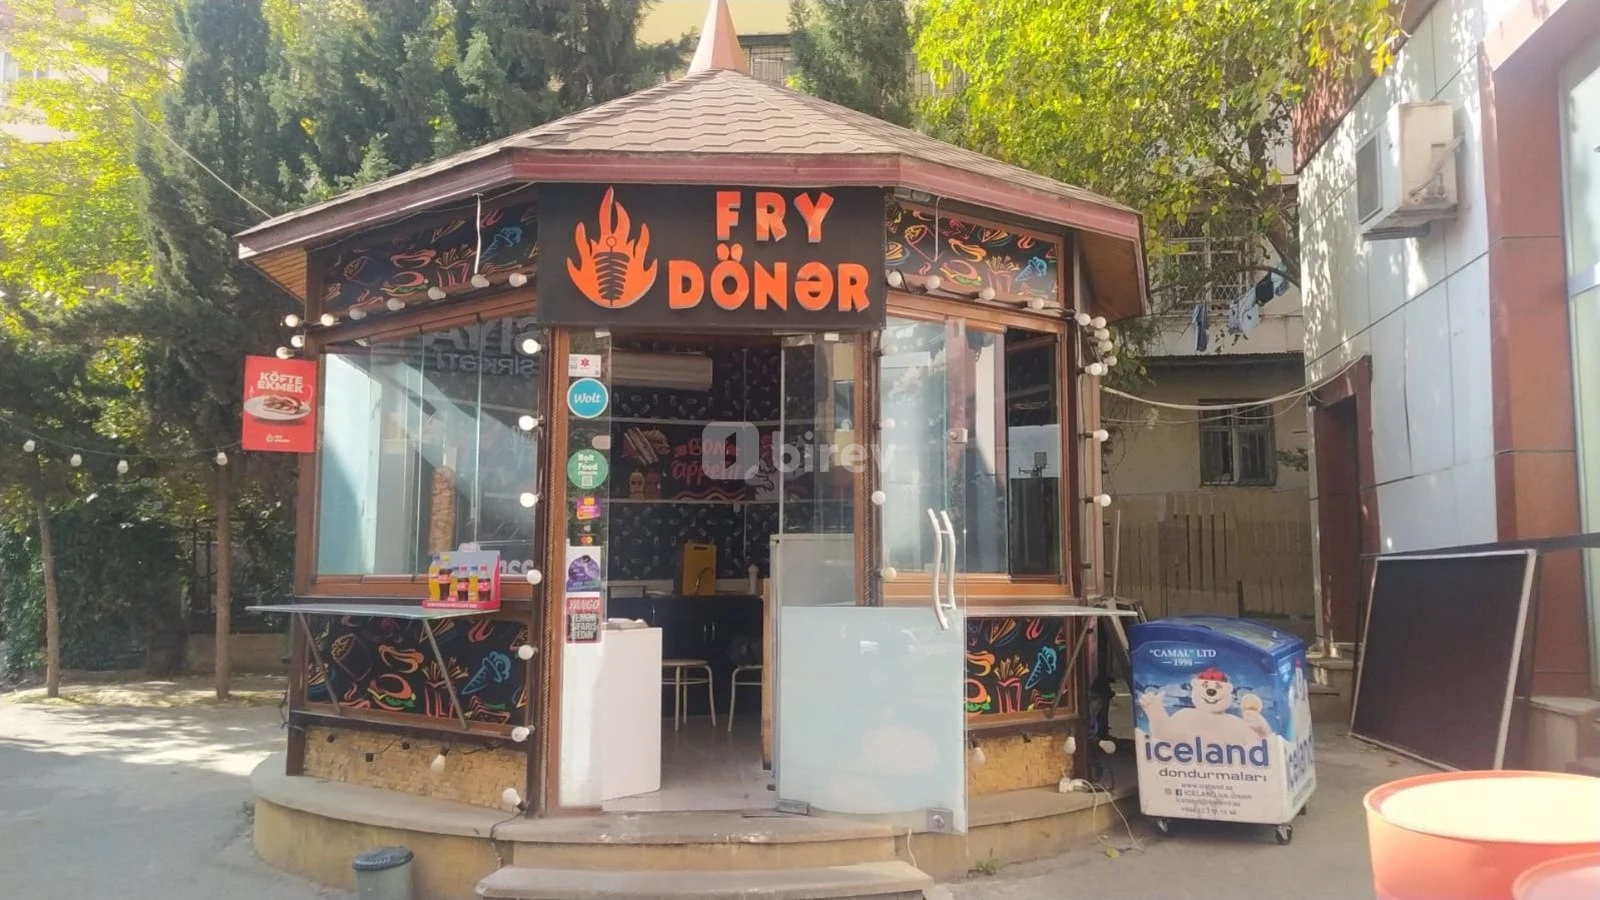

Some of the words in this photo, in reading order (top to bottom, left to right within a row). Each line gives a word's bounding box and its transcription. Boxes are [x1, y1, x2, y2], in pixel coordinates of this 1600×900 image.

[716, 190, 834, 243] FRY
[668, 243, 870, 313] DÖNƏR
[260, 371, 303, 385] KÖFTE
[257, 381, 304, 394] EKMEK
[573, 393, 602, 404] Wolt
[578, 453, 595, 463] Bolt
[578, 462, 598, 472] Food
[569, 599, 601, 612] YANGO
[1196, 649, 1217, 658] LTD
[1173, 658, 1193, 667] 1998
[1144, 735, 1270, 767] iceland
[1158, 768, 1268, 782] dondurmaları
